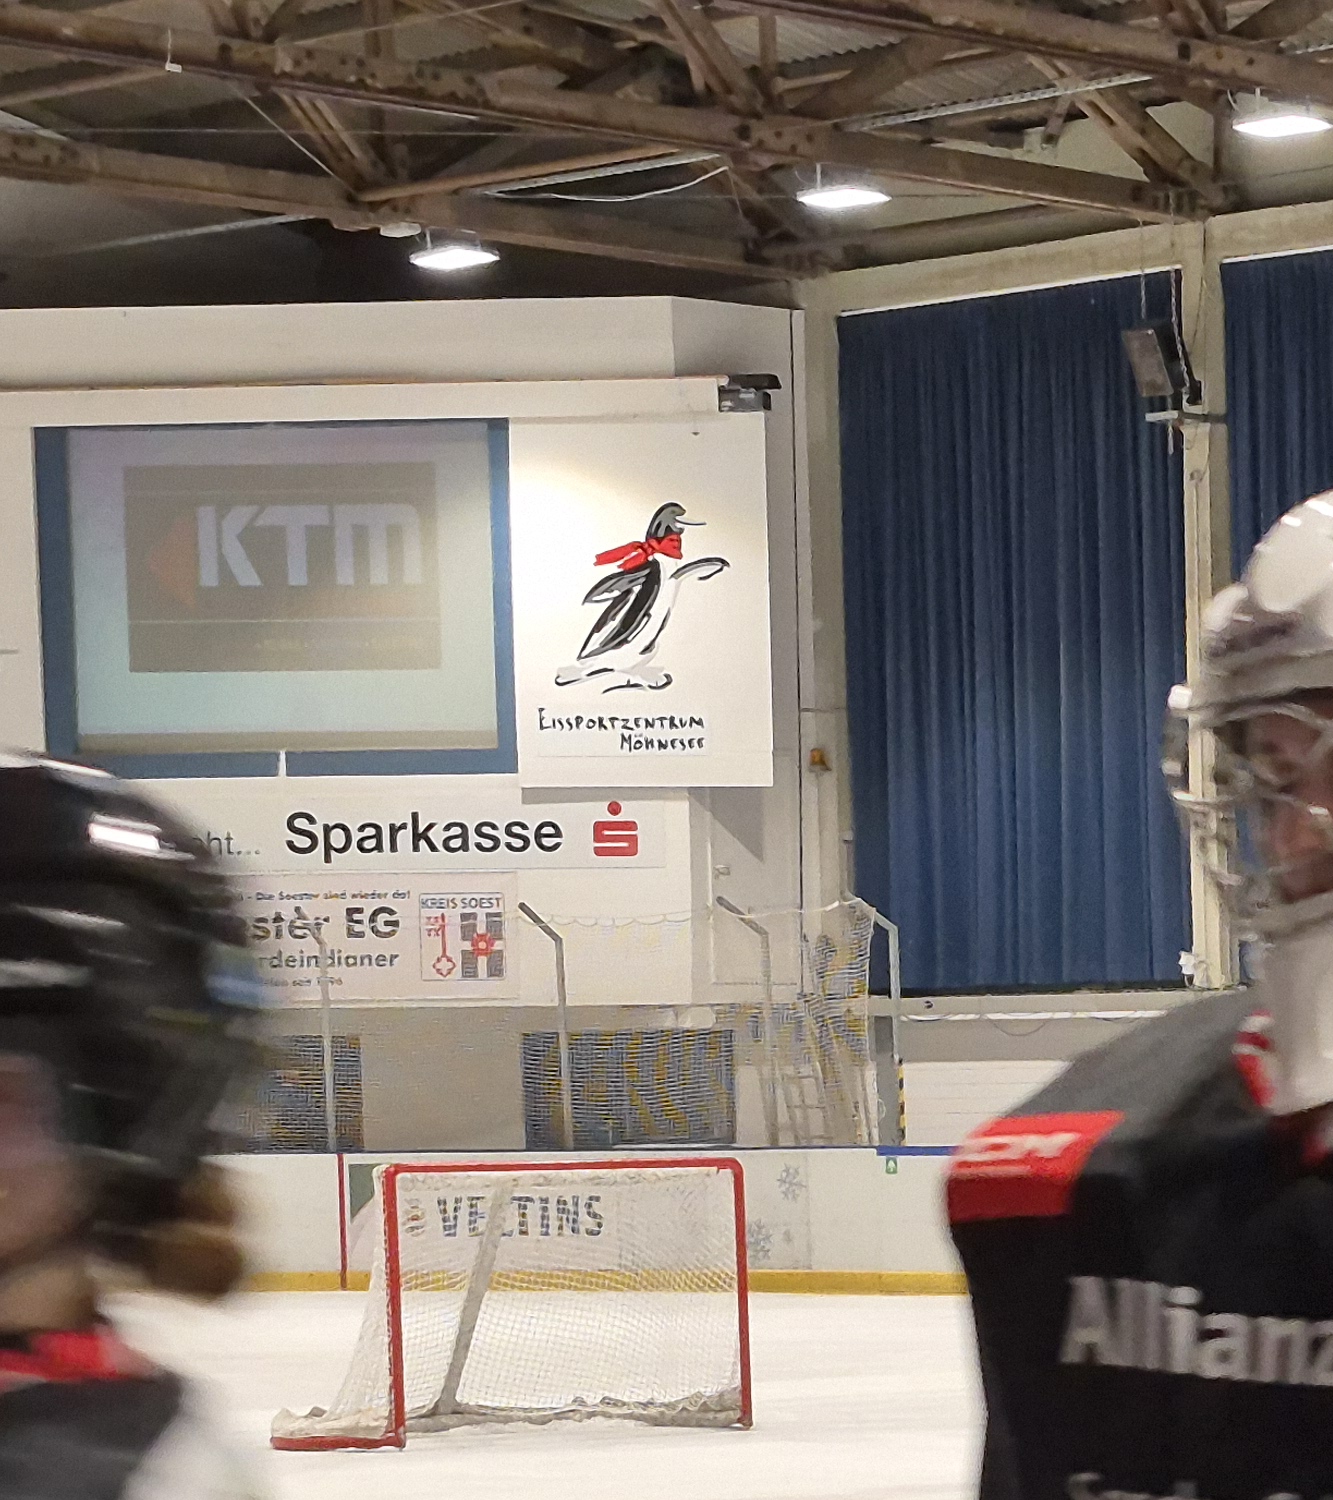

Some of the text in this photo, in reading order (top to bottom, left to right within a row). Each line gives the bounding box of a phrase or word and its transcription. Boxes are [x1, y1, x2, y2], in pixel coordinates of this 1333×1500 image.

[196, 504, 423, 587] KTM
[285, 811, 564, 863] Sparkasse
[345, 906, 400, 939] EG
[460, 897, 502, 910] SOEST
